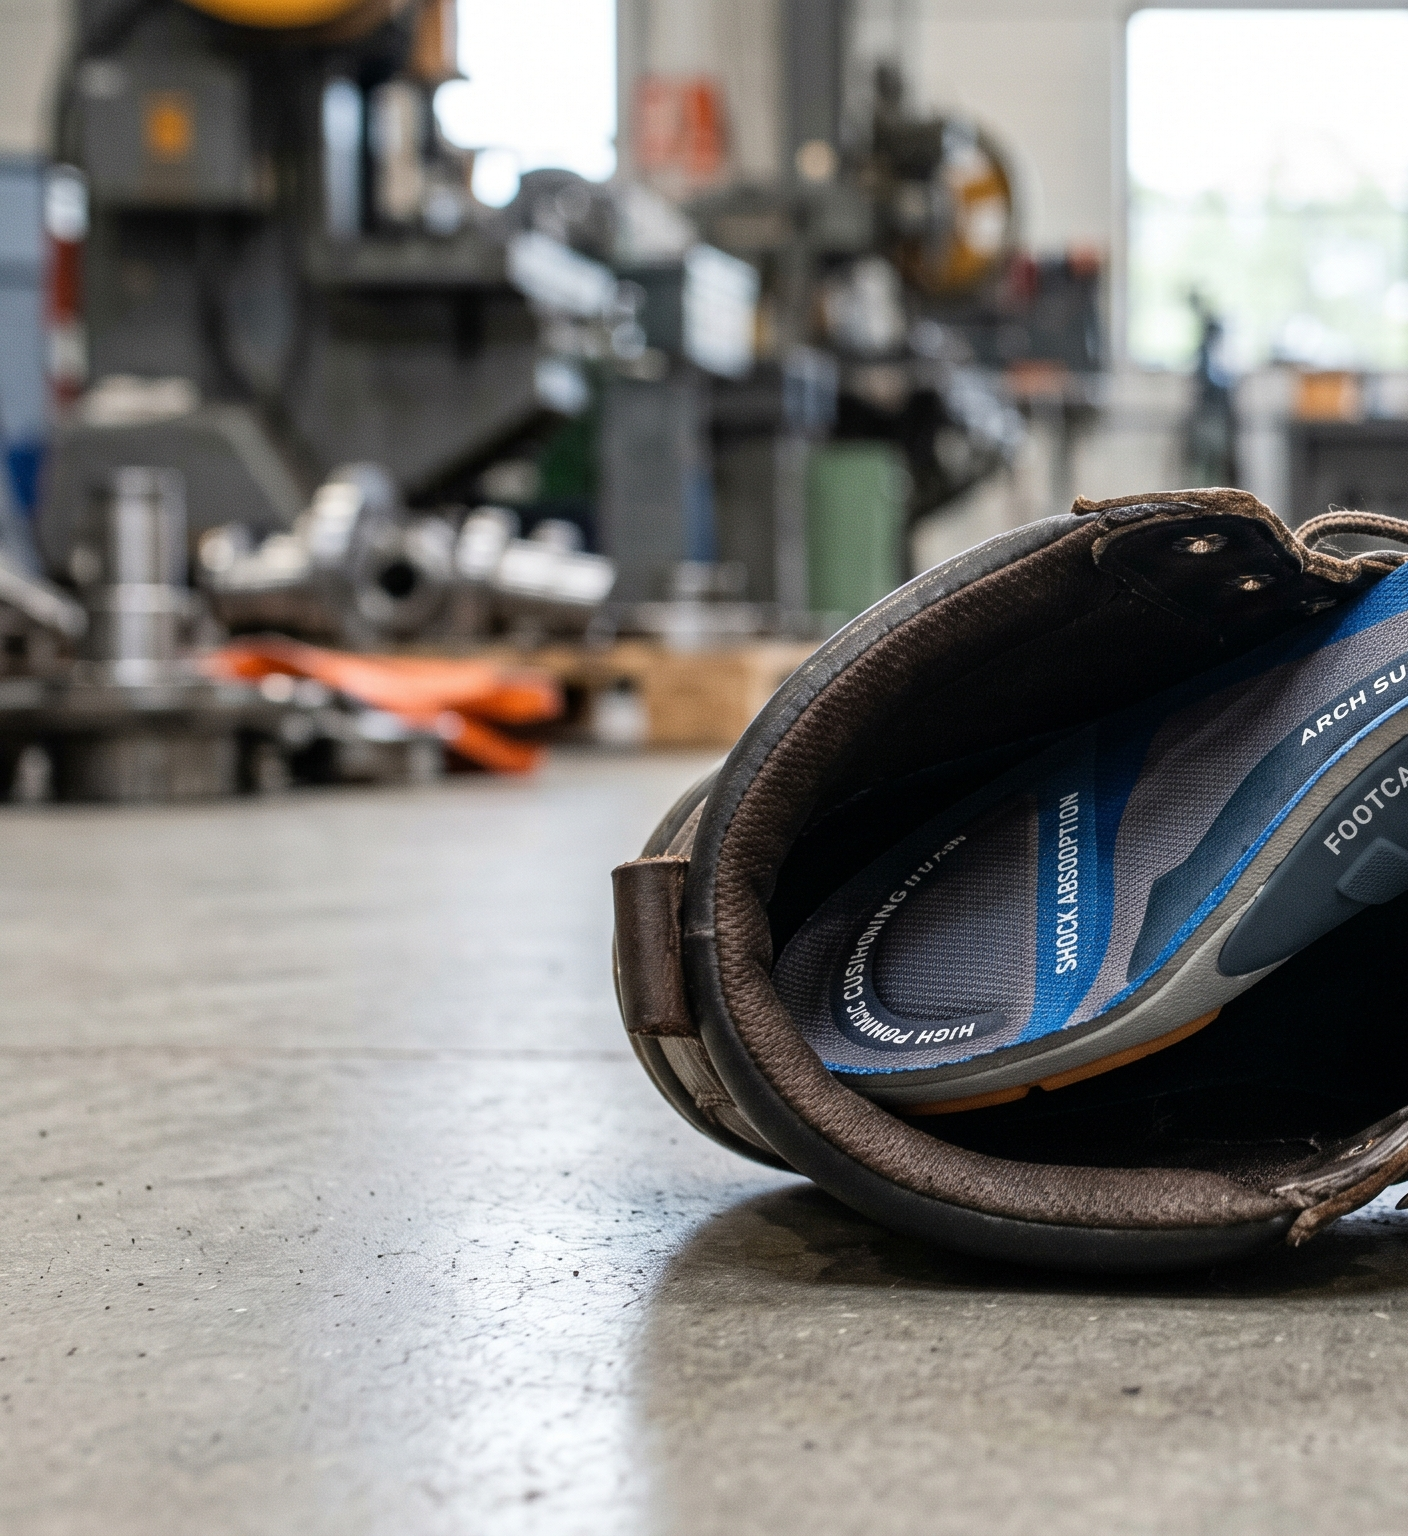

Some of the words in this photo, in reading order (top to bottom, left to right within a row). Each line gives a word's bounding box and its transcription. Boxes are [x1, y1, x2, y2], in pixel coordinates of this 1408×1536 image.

[1300, 691, 1367, 746] ARCH
[1055, 907, 1079, 975] SHOCK
[915, 1023, 976, 1045] HIGH
